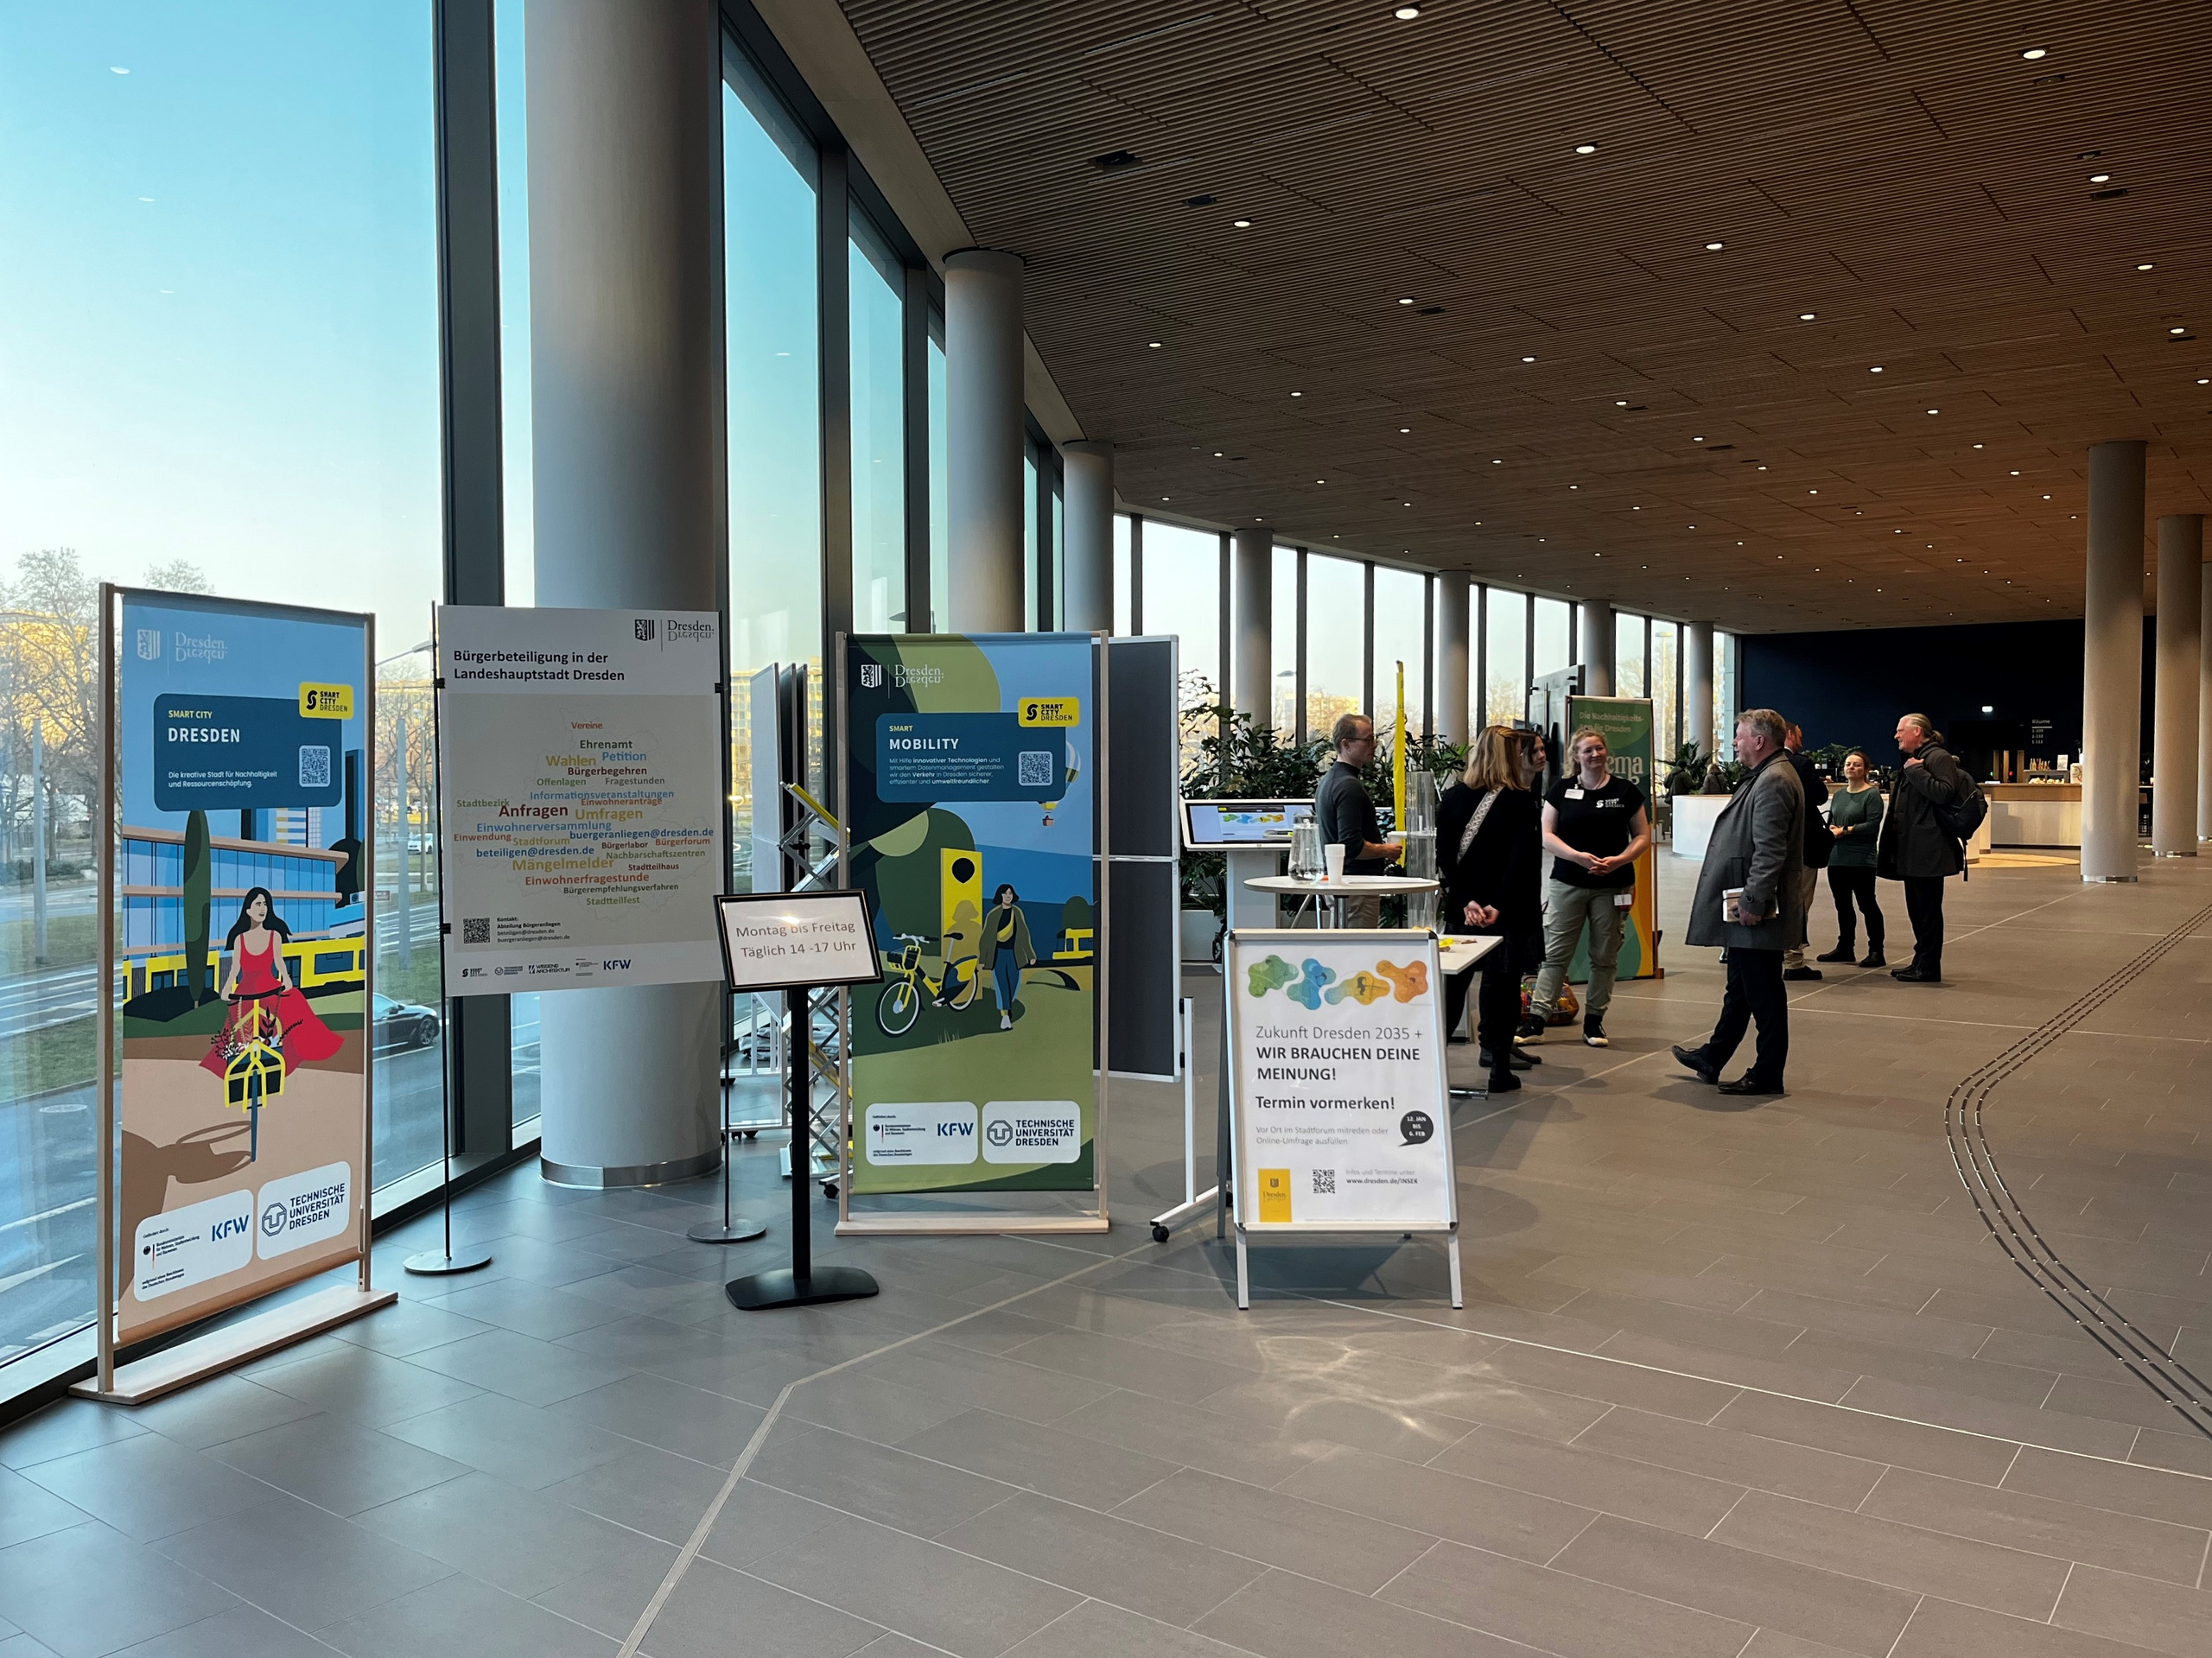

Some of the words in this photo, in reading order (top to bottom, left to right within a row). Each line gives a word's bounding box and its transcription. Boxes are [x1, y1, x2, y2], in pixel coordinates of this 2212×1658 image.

[667, 619, 715, 632] Dresden.
[175, 632, 228, 650] Dresden.
[454, 650, 569, 665] Bürgerbeteiligung
[572, 651, 583, 664] in
[587, 652, 608, 664] der
[454, 668, 569, 683] Landeshauptstadt
[573, 669, 625, 681] Dresden
[895, 664, 944, 677] Dresden.
[168, 710, 194, 719] SMART
[168, 727, 240, 743] DRESDEN
[580, 740, 632, 749] Ehrenamt
[889, 738, 959, 750] MOBILITY
[546, 755, 596, 766] Wahlen
[601, 752, 646, 762] Petition
[235, 771, 277, 779] Nachhaltigkeit
[568, 765, 647, 777] Bürgerbegehren
[182, 779, 253, 789] Ressourcenschöpfung.
[537, 777, 587, 787] Offenlagen
[605, 776, 665, 786] Fragestunden
[530, 790, 674, 800] Informationsveranstaltungen
[457, 798, 510, 808] Stadtbezirk
[581, 797, 663, 807] Einwohneranträge
[499, 804, 569, 819] Anfragen
[575, 808, 643, 822] Umfragen
[476, 821, 612, 833] Einwohnerversammlung
[454, 833, 512, 842] Einwendung
[569, 828, 714, 841] buergeranliegen@dresden.de
[512, 836, 570, 847] Stadtforum
[601, 841, 648, 850] Bürgerlabor
[655, 837, 710, 848] Bürgerforum
[476, 845, 594, 859] beteiligen@dresden.de
[606, 849, 706, 860] Nachbarschaftszentren
[512, 857, 615, 873] Mängelmelder
[628, 862, 679, 871] Stadtteilhaus
[525, 872, 650, 886] Einwohnerfragestunde
[563, 883, 679, 895] Bürgerempfehlungsverfahren
[586, 895, 640, 905] Stadtteilfest
[736, 926, 787, 937] Montag
[791, 923, 809, 934] bis
[812, 921, 855, 933] Freitag
[741, 944, 785, 959] Täglich
[790, 943, 805, 955] 14
[810, 942, 829, 953] -17
[833, 940, 856, 952] Uhr
[603, 959, 632, 971] KFW
[1255, 1025, 1308, 1039] Zukunft
[1313, 1026, 1370, 1039] Dresden
[1376, 1027, 1409, 1039] 2035
[1414, 1030, 1422, 1039] +
[1256, 1046, 1287, 1059] WIR
[1291, 1047, 1371, 1060] BRAUCHEN
[1376, 1048, 1420, 1060] DEINE
[1257, 1067, 1337, 1080] MEINUNG!
[1255, 1096, 1306, 1109] Termin
[1310, 1096, 1395, 1109] vormerken!
[938, 1122, 974, 1136] KFW
[1015, 1119, 1075, 1128] TECHNISCHE
[1015, 1127, 1074, 1137] UNIVERSITÄT
[1256, 1137, 1313, 1146] Online-Umfrage
[290, 1183, 345, 1208] TECHNISCHE
[289, 1193, 345, 1218] UNIVERSITÄT
[289, 1210, 330, 1230] DRESDEN
[212, 1215, 249, 1242] KFW
